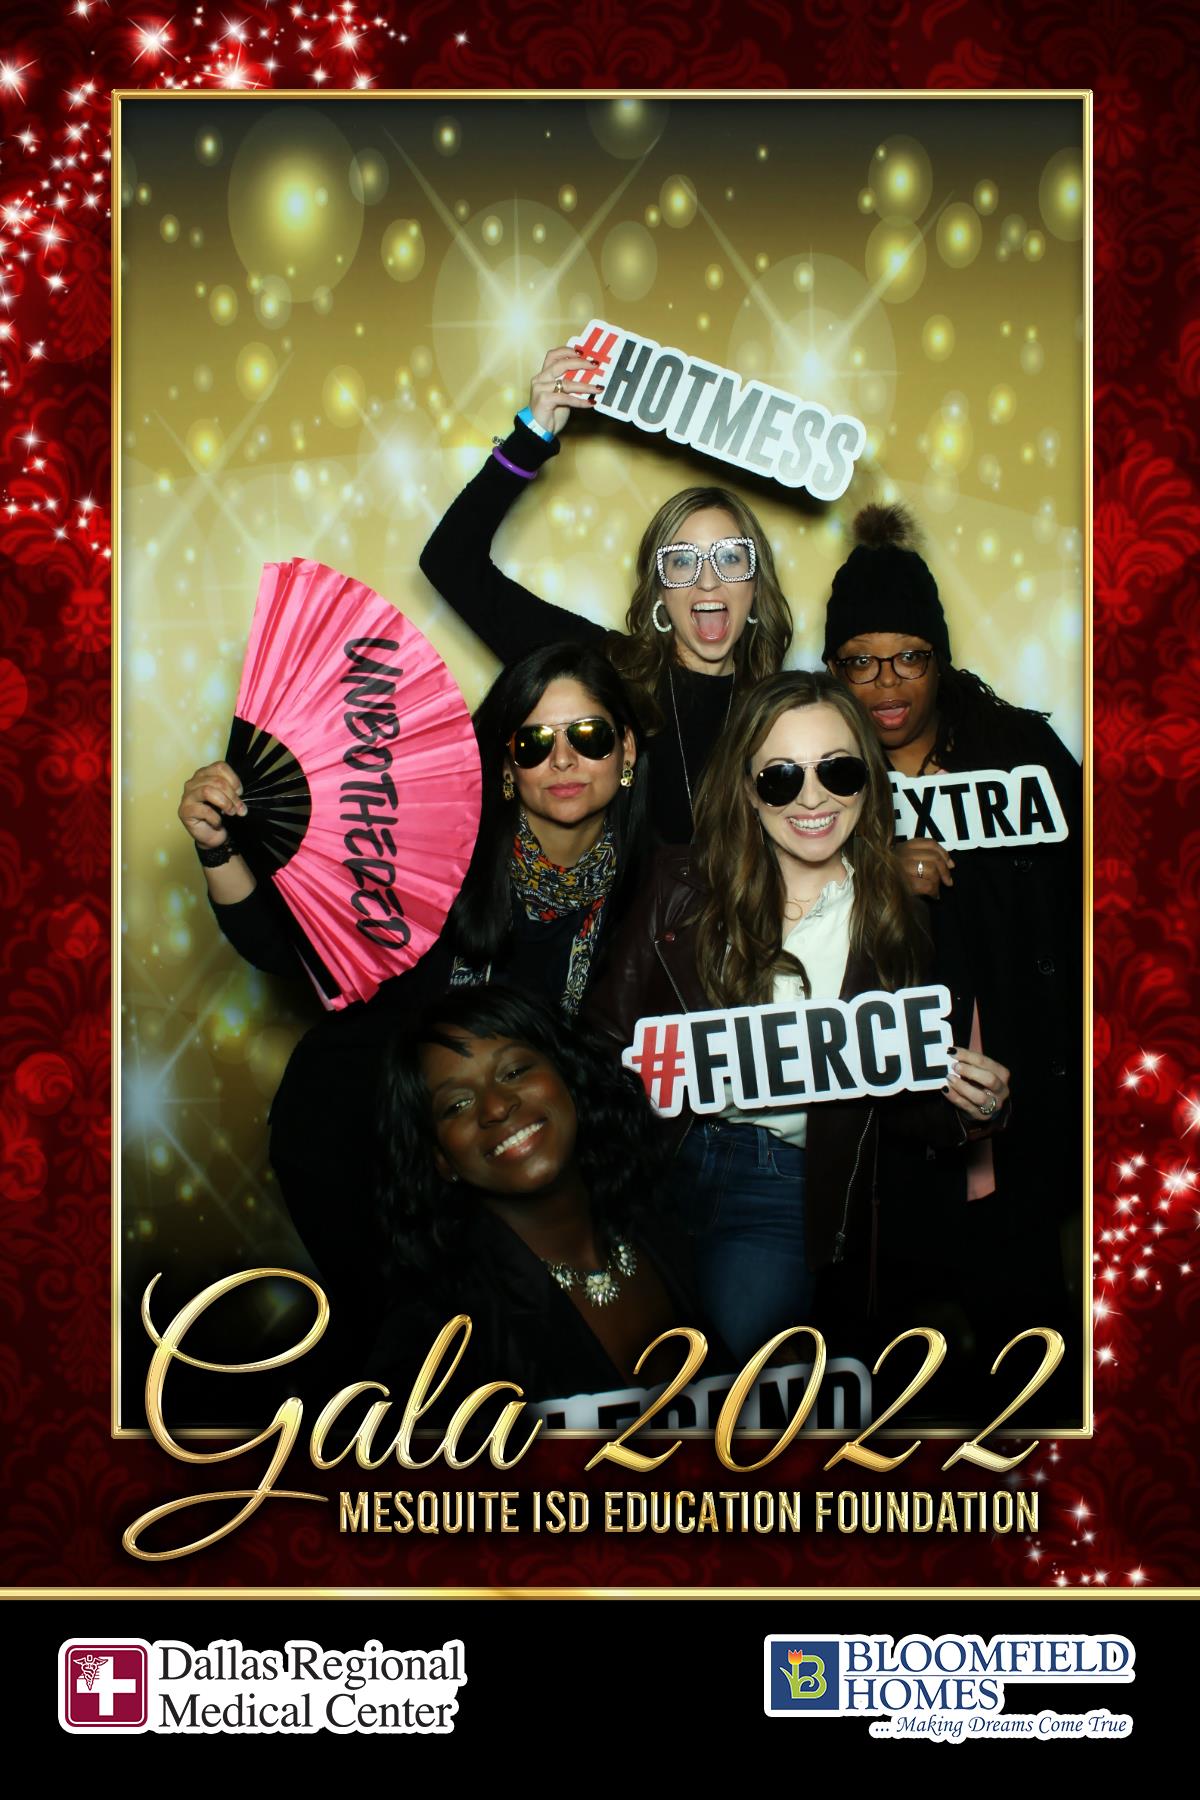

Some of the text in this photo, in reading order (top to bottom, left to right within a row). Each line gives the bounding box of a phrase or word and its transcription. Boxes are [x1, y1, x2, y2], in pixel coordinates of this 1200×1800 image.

[563, 326, 859, 494] #HOTMESS
[339, 636, 412, 951] UNBOTHERED
[631, 994, 949, 1109] #FIERCE
